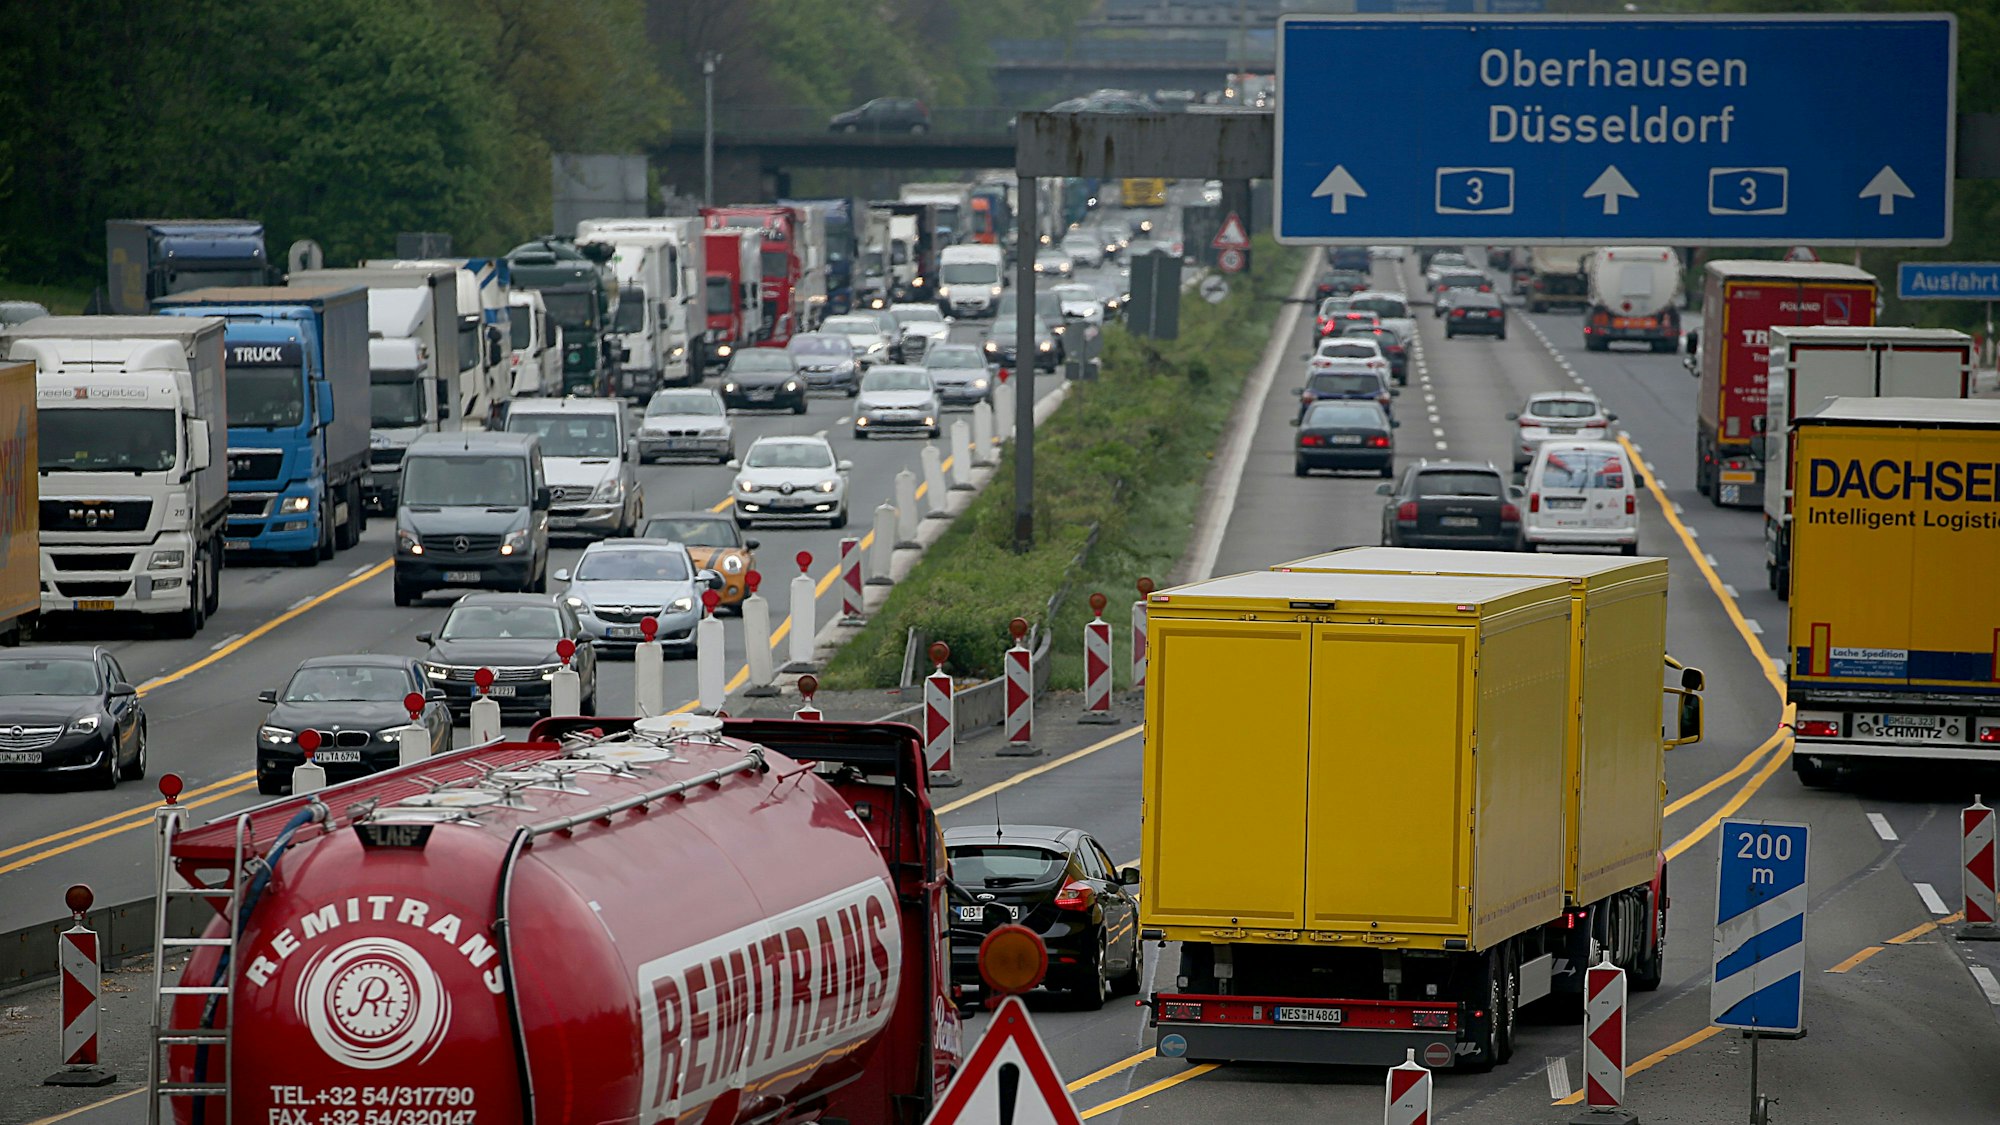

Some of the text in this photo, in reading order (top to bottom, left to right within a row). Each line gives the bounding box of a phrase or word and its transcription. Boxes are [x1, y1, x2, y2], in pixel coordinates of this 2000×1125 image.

[1480, 48, 1748, 89] Oberhausen
[1489, 104, 1736, 145] Düsseldorf
[1465, 177, 1485, 206] 3
[1739, 177, 1758, 206] 3
[1911, 271, 1998, 291] Ausfahrt
[233, 347, 282, 363] TRUCK
[91, 387, 145, 401] logistics
[1809, 457, 2000, 503] DACHSE
[68, 508, 115, 520] MAN
[1809, 506, 2000, 532] Intelligent Logisti
[1862, 649, 1905, 660] Spedition
[1918, 717, 1935, 727] 323
[1875, 727, 1942, 739] SCHMITZ
[27, 753, 41, 763] 309
[1737, 832, 1792, 861] 200
[1752, 867, 1774, 885] m
[245, 895, 506, 995] REMITRANS
[651, 894, 890, 1108] REMITRANS
[1281, 1008, 1340, 1021] WES H 4861
[361, 1086, 475, 1106] 54/317790
[268, 1108, 477, 1125] FAX. +32 54/320147
